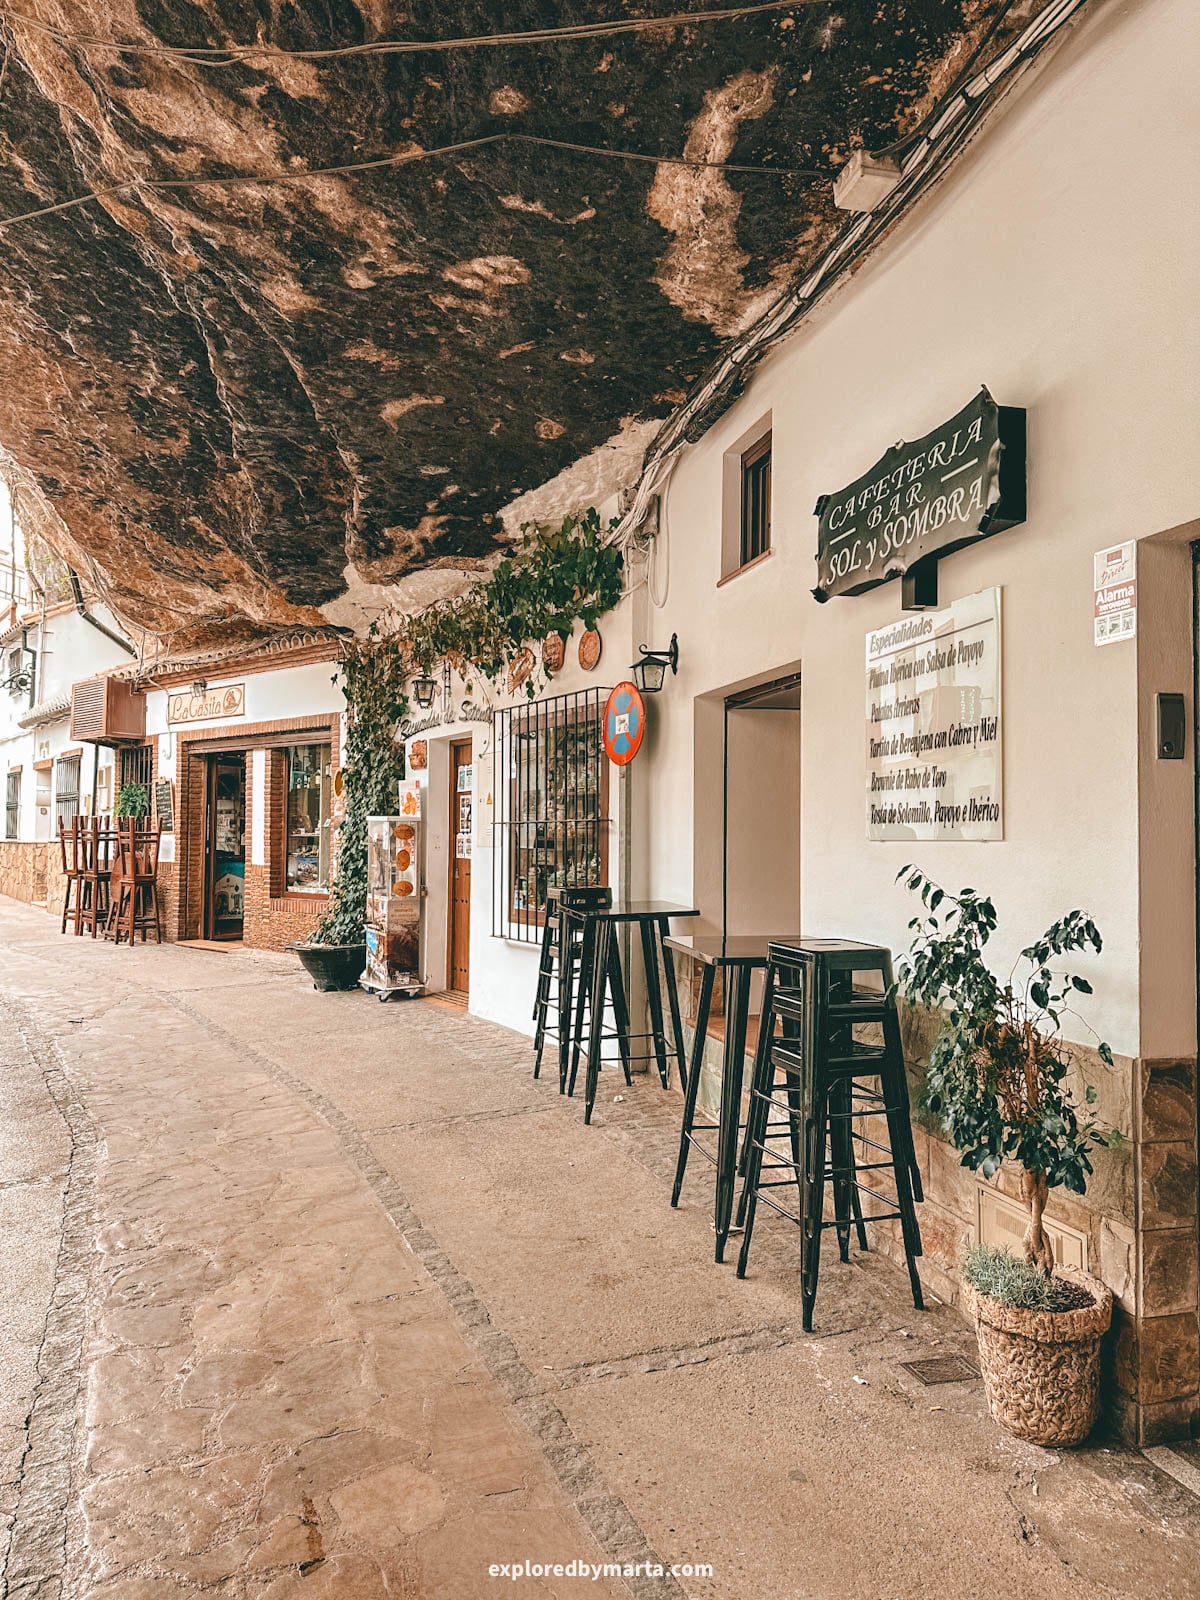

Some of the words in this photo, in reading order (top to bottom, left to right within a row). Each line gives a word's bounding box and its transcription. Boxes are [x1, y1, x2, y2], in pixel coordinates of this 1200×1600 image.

[829, 416, 983, 530] CAFETERIA
[867, 482, 926, 530] BAR
[826, 540, 862, 585] SOL
[865, 538, 877, 570] y
[879, 475, 984, 558] SOMBRA
[1095, 585, 1135, 606] Alarma
[870, 617, 933, 654] Especialidades
[913, 658, 925, 676] con
[926, 648, 946, 674] Salsa
[947, 644, 957, 667] de
[957, 640, 984, 668] Payoyo
[189, 696, 221, 718] Casita
[890, 734, 899, 756] de
[899, 729, 933, 758] Berenjena
[934, 731, 947, 749] con
[948, 722, 972, 747] Cabra
[972, 725, 979, 749] y
[979, 716, 998, 742] Miel
[871, 770, 896, 791] Brownie
[896, 769, 904, 790] de
[905, 768, 921, 790] Rabo
[922, 767, 930, 789] de
[932, 766, 947, 788] Toro
[888, 803, 897, 825] de
[934, 800, 961, 828] Payoyo
[962, 803, 968, 822] e
[968, 796, 1000, 822] Ibérico
